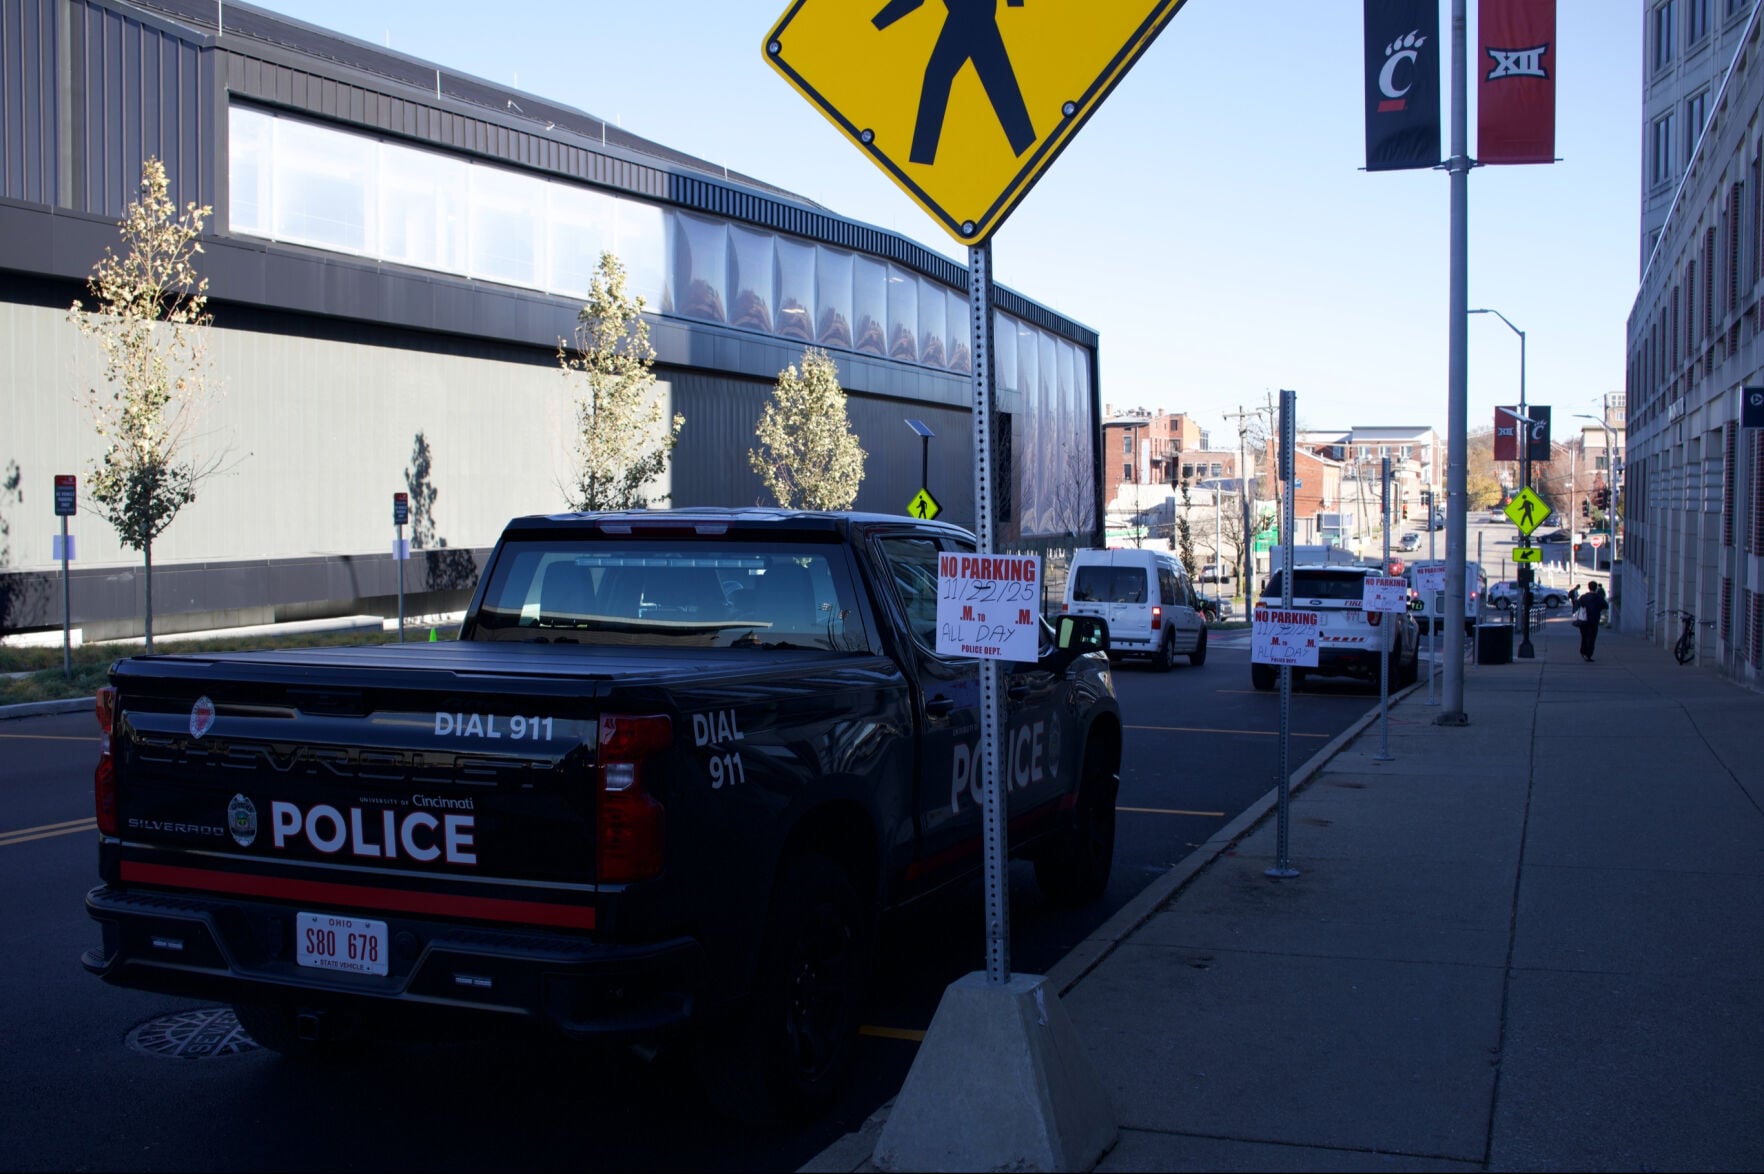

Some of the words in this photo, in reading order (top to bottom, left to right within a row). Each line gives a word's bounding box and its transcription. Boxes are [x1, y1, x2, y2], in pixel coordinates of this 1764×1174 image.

[1486, 44, 1549, 81] XII
[941, 556, 958, 578] NO
[961, 557, 1036, 582] PARKING
[943, 578, 1034, 602] 11/22/25
[1366, 578, 1375, 586] NO
[1376, 579, 1406, 588] PARKING
[978, 613, 986, 622] TO
[1255, 610, 1269, 622] NO
[1271, 611, 1318, 625] PARKING
[942, 622, 965, 642] ALL
[976, 625, 1016, 643] DAY
[961, 644, 981, 654] POLICE
[983, 646, 1002, 656] DEPT.
[1257, 646, 1275, 659] ALL
[1284, 646, 1310, 658] DAY
[434, 711, 502, 738] DIAL
[509, 714, 553, 740] 911
[692, 709, 745, 747] DIAL
[709, 752, 745, 789] 911
[951, 720, 1045, 814] POICE
[412, 794, 475, 810] Cincinnati
[128, 818, 225, 836] SILVERADO
[270, 800, 479, 865] POLICE
[328, 918, 352, 928] OHIO
[306, 928, 336, 957] S80
[348, 932, 378, 962] 678
[339, 961, 365, 971] VEHICLE
